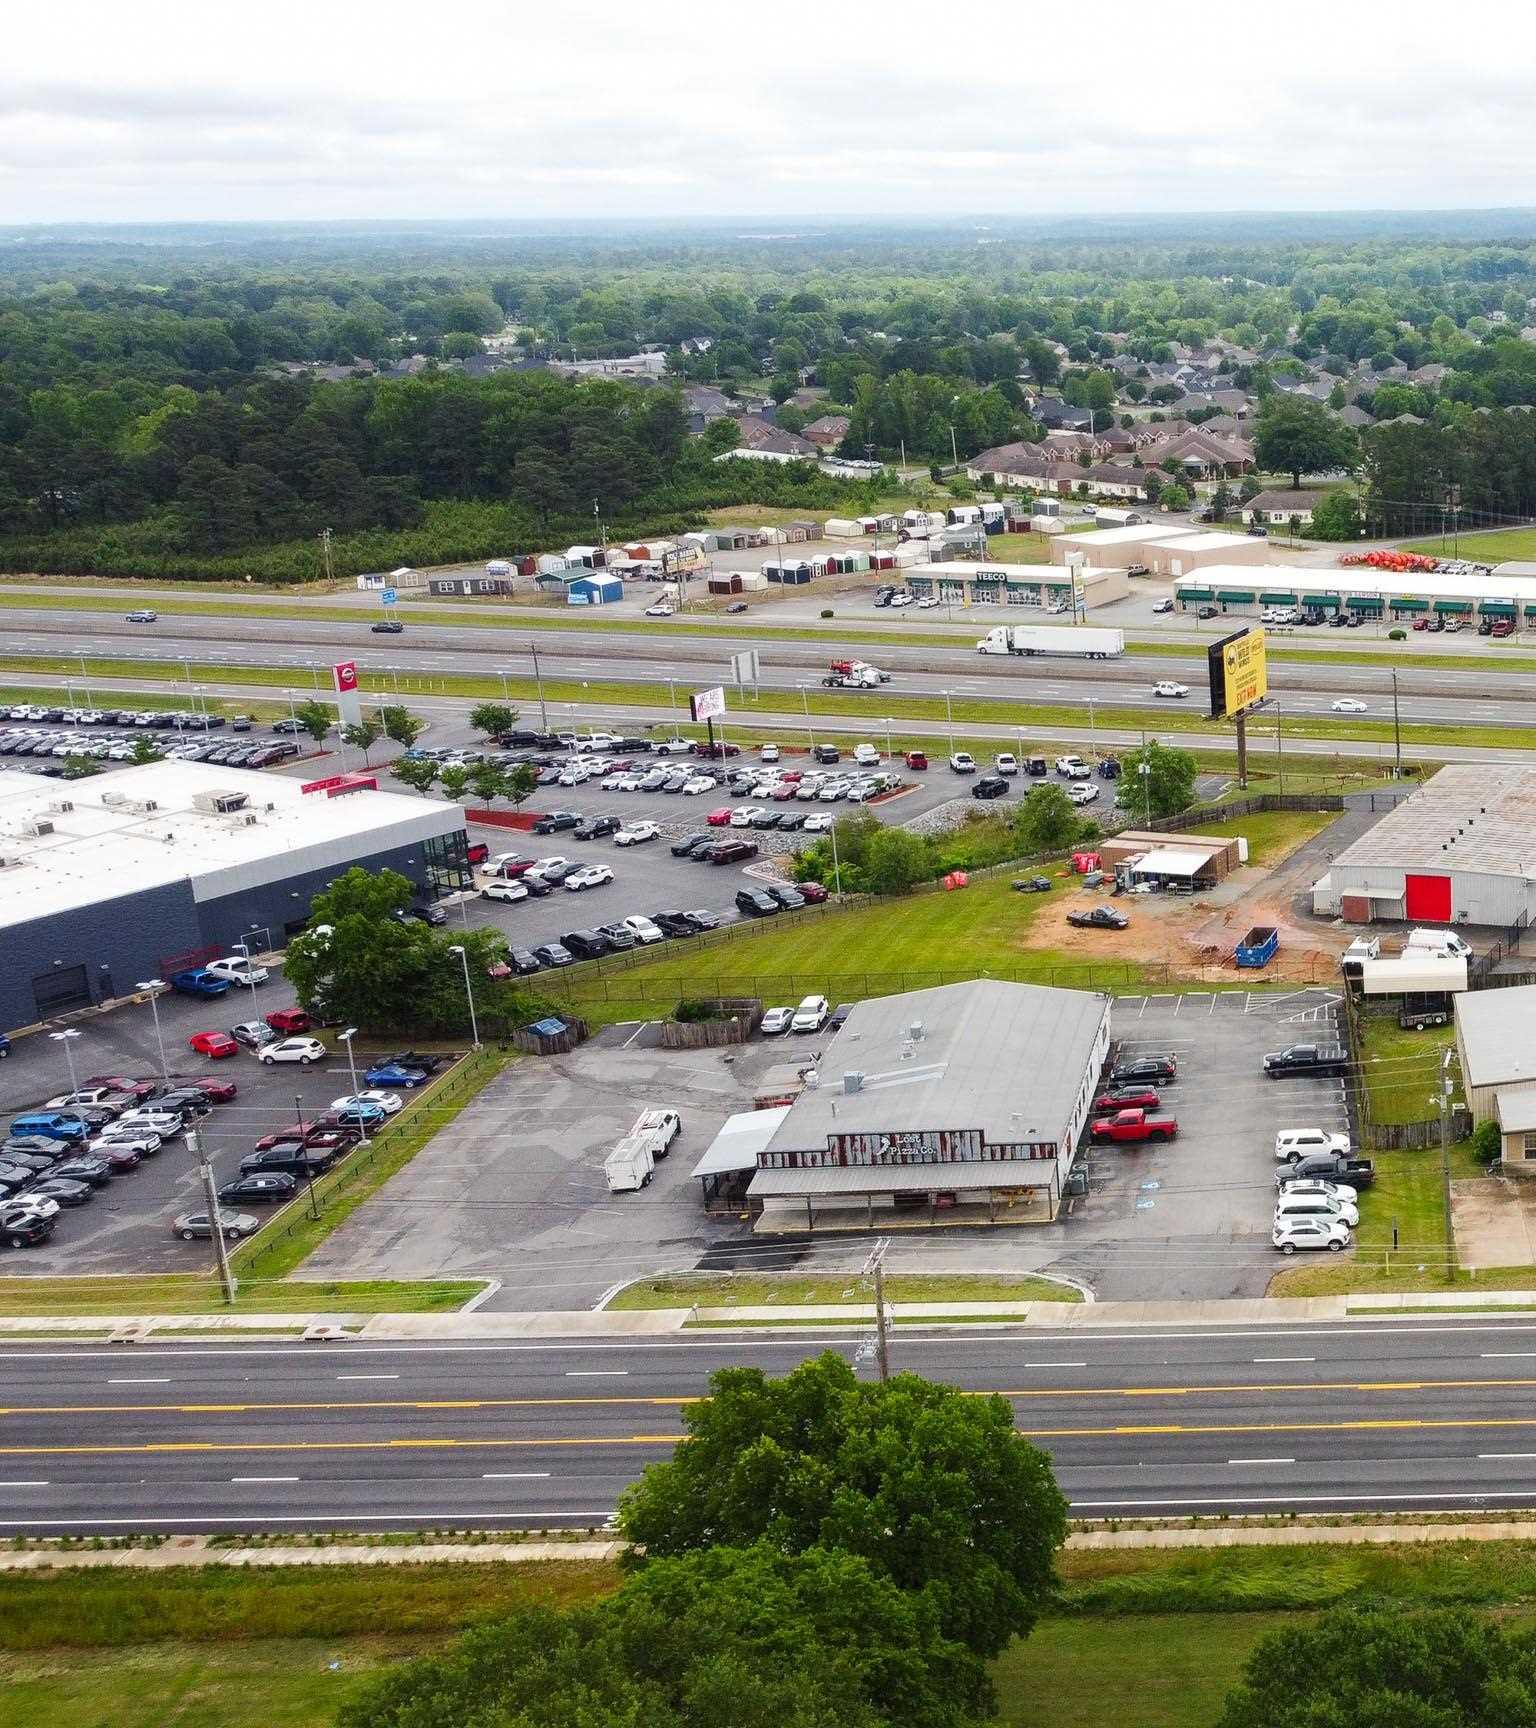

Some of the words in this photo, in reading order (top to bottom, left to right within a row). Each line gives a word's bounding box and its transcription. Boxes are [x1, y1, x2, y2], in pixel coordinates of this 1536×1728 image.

[978, 573, 1006, 581] TEECO
[896, 1134, 921, 1144] Lost
[889, 1146, 919, 1155] Pizza
